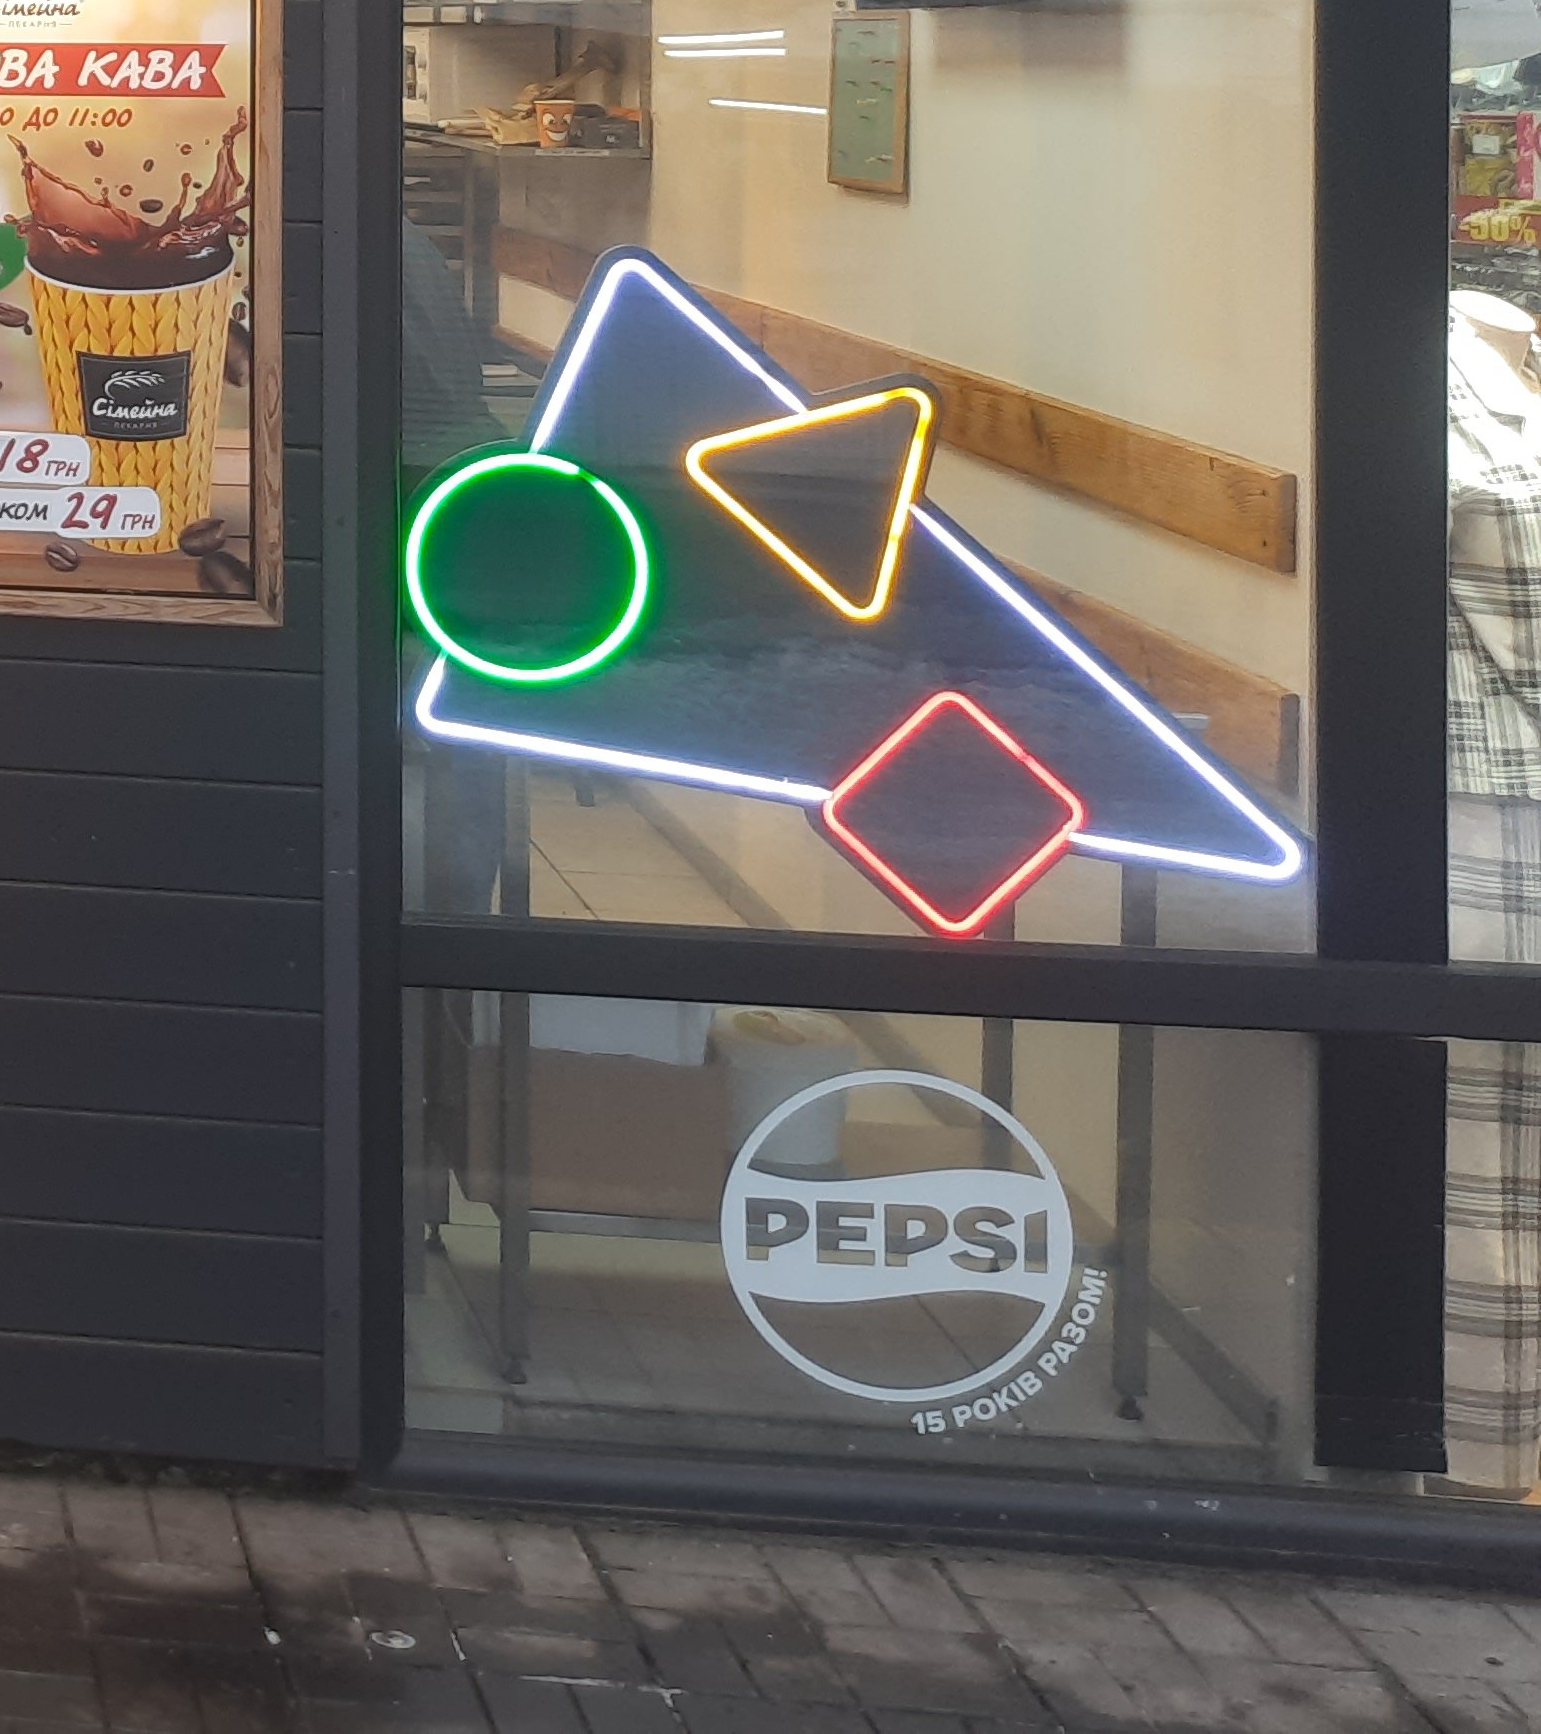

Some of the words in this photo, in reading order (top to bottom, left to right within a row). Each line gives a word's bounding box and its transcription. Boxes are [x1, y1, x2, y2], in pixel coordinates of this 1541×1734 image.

[77, 50, 207, 92] КАВА
[22, 107, 59, 131] ДО
[68, 107, 134, 129] 11:00
[92, 397, 179, 419] Сімейна
[45, 459, 81, 479] ГРН
[60, 491, 118, 531] 29
[120, 512, 156, 532] ГРН
[744, 1195, 1051, 1274] PEPSI
[910, 1409, 946, 1436] 15
[951, 1369, 1042, 1430] РОКІВ
[1037, 1266, 1108, 1376] РАЗОМ!
